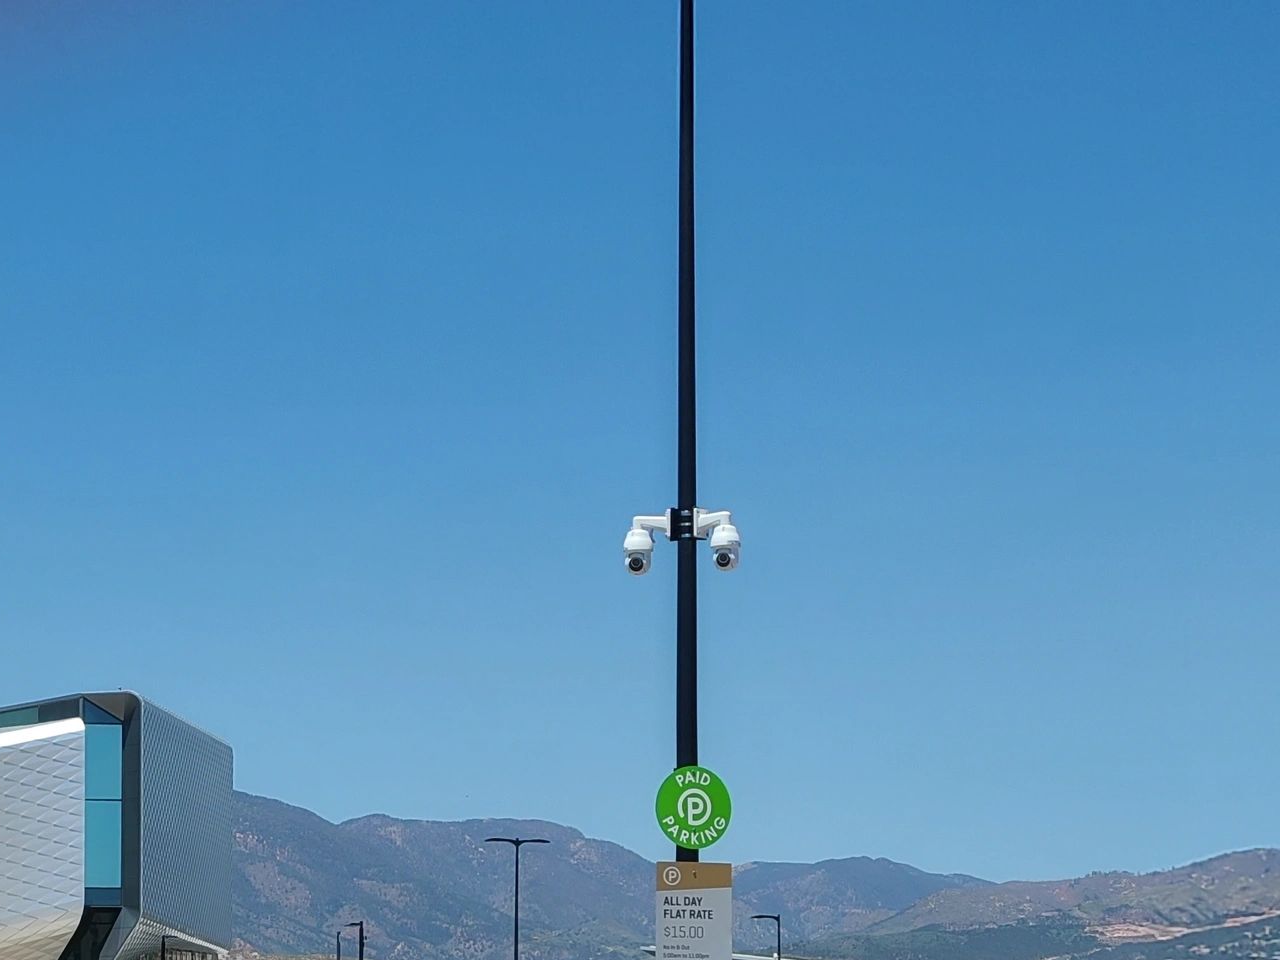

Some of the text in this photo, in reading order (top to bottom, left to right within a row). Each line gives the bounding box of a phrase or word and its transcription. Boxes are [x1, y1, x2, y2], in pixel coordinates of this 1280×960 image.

[675, 771, 711, 787] PAID
[662, 815, 726, 845] PARKING
[663, 896, 703, 907] ALL DAY
[663, 909, 714, 920] FLAT RATE
[663, 925, 704, 939] $15.00
